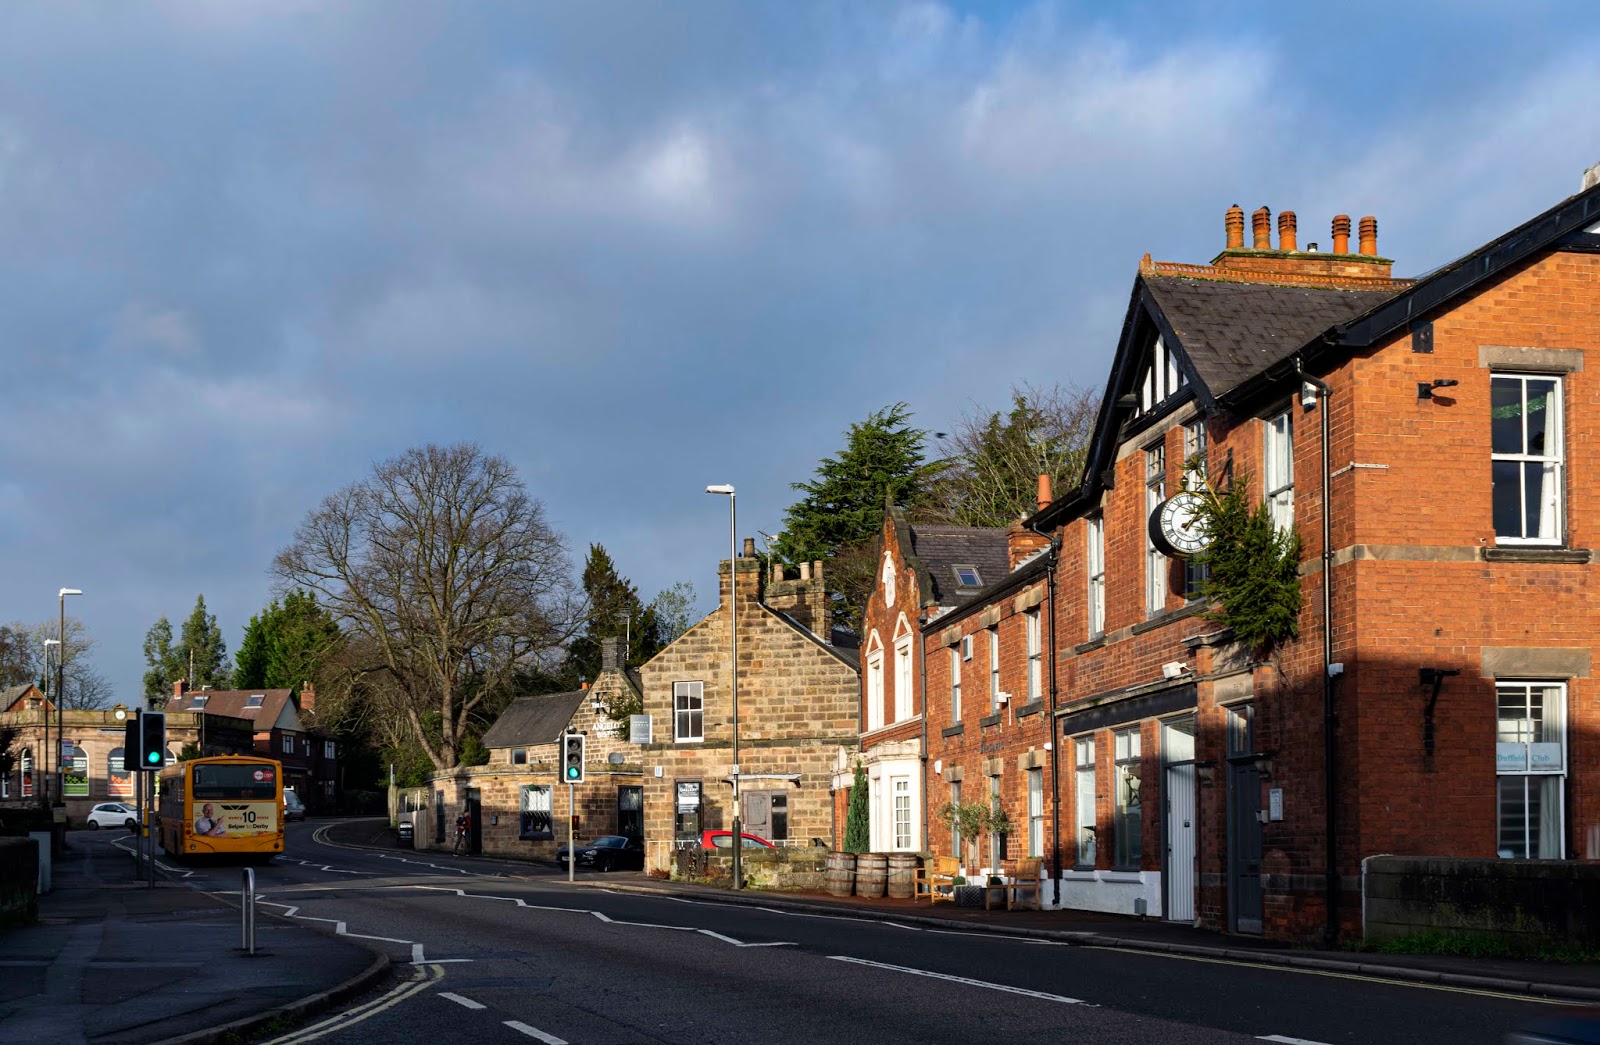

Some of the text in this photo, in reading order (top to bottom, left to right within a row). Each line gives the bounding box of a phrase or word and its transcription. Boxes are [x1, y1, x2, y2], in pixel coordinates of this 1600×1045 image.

[1497, 753, 1550, 762] Duffield Club
[243, 811, 256, 823] 10
